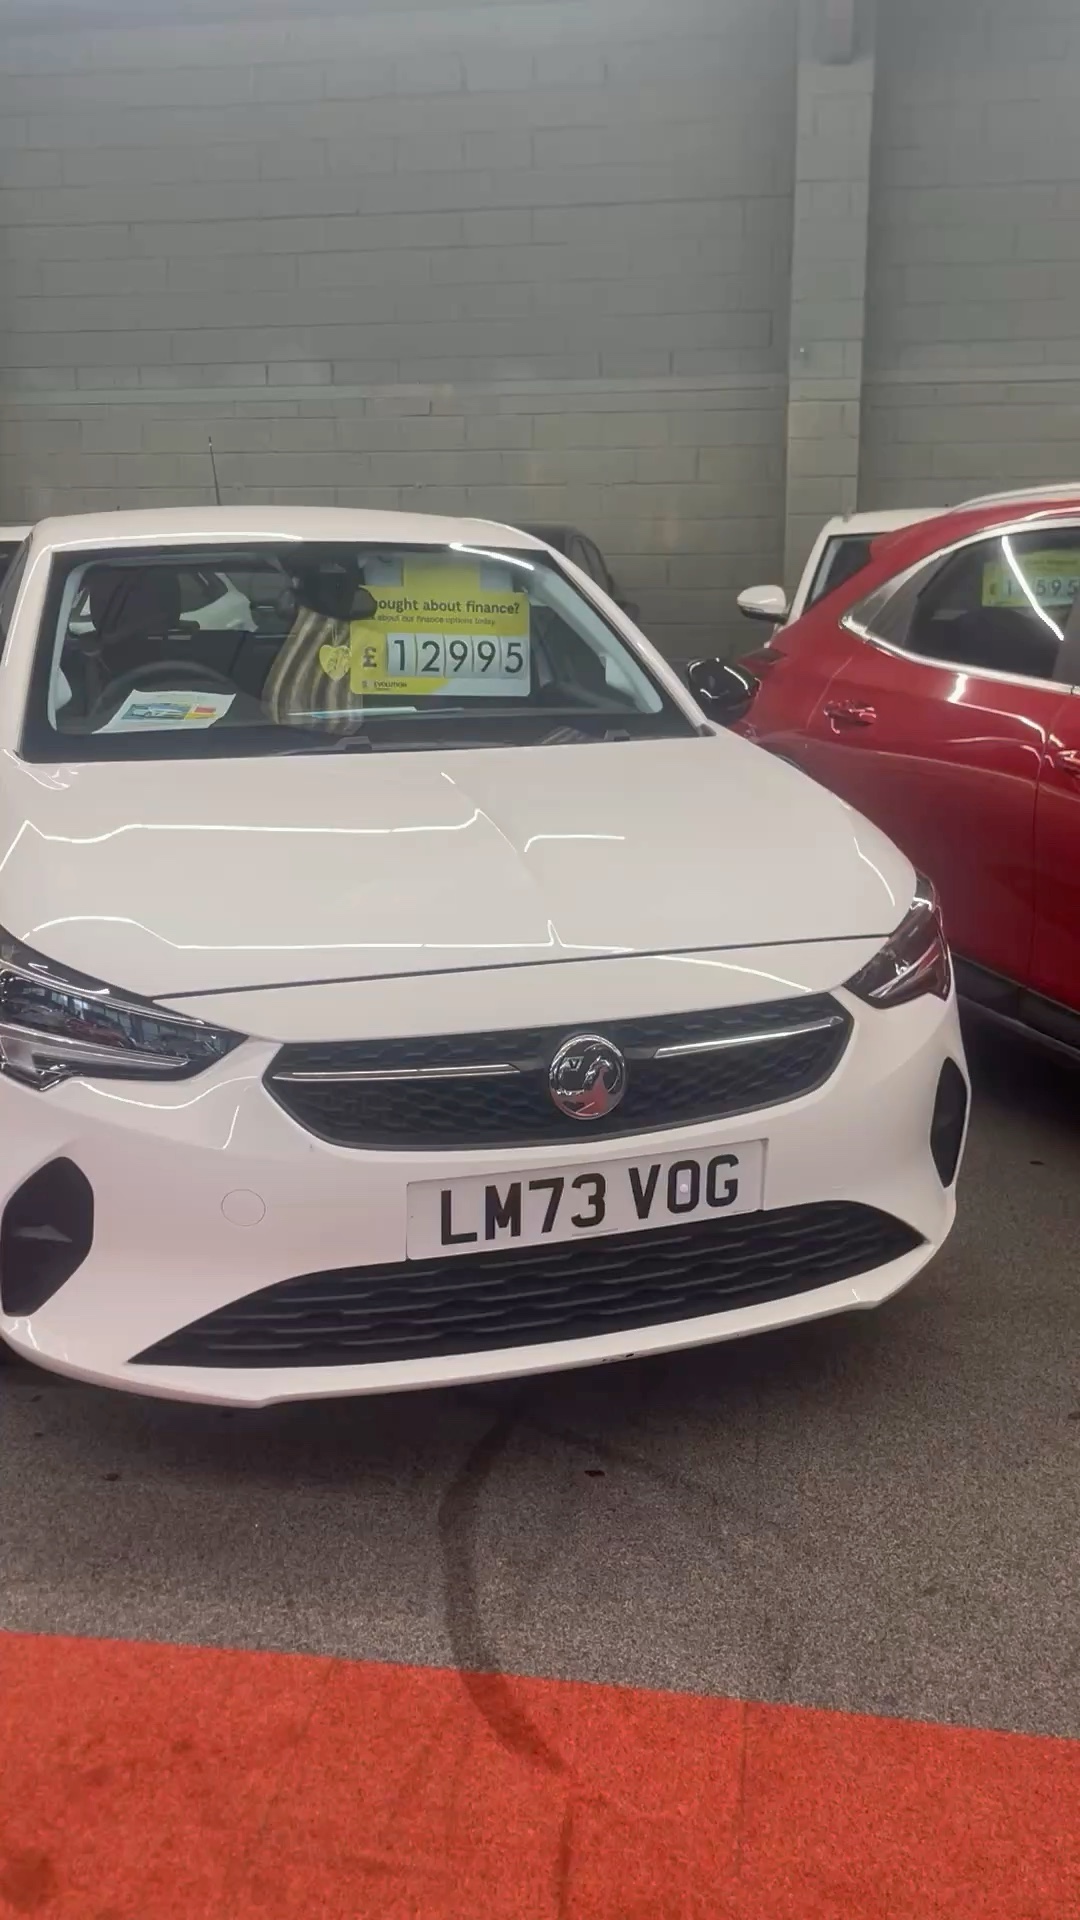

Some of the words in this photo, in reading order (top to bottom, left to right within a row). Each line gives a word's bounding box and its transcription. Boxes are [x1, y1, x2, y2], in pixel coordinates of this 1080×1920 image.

[376, 597, 419, 613] ought
[423, 600, 461, 612] about
[466, 600, 519, 614] finance?
[394, 639, 524, 674] 12995
[440, 1172, 607, 1246] LM73
[628, 1153, 739, 1220] VOG
